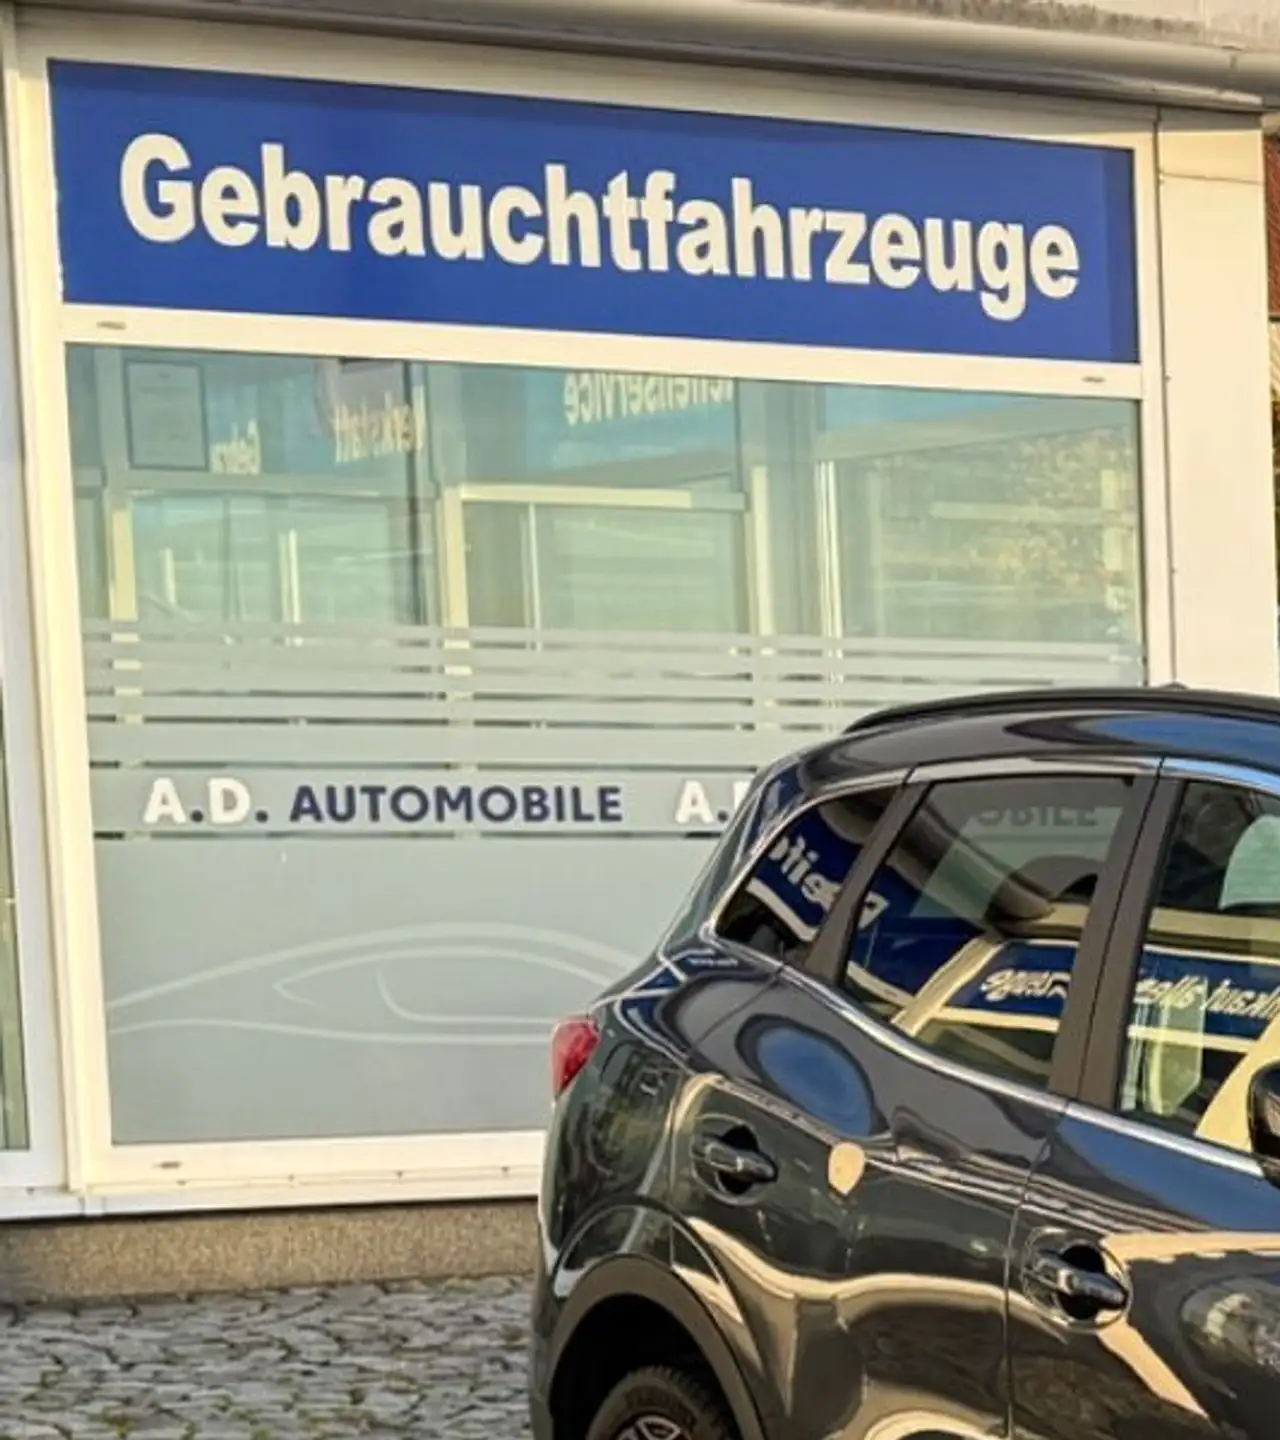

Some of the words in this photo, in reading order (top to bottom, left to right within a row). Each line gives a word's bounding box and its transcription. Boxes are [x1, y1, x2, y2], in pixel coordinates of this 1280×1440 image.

[119, 133, 1078, 321] Gebrauchtfahrzeuge
[143, 778, 269, 824] A.D.
[290, 785, 623, 823] AUTOMOBILE
